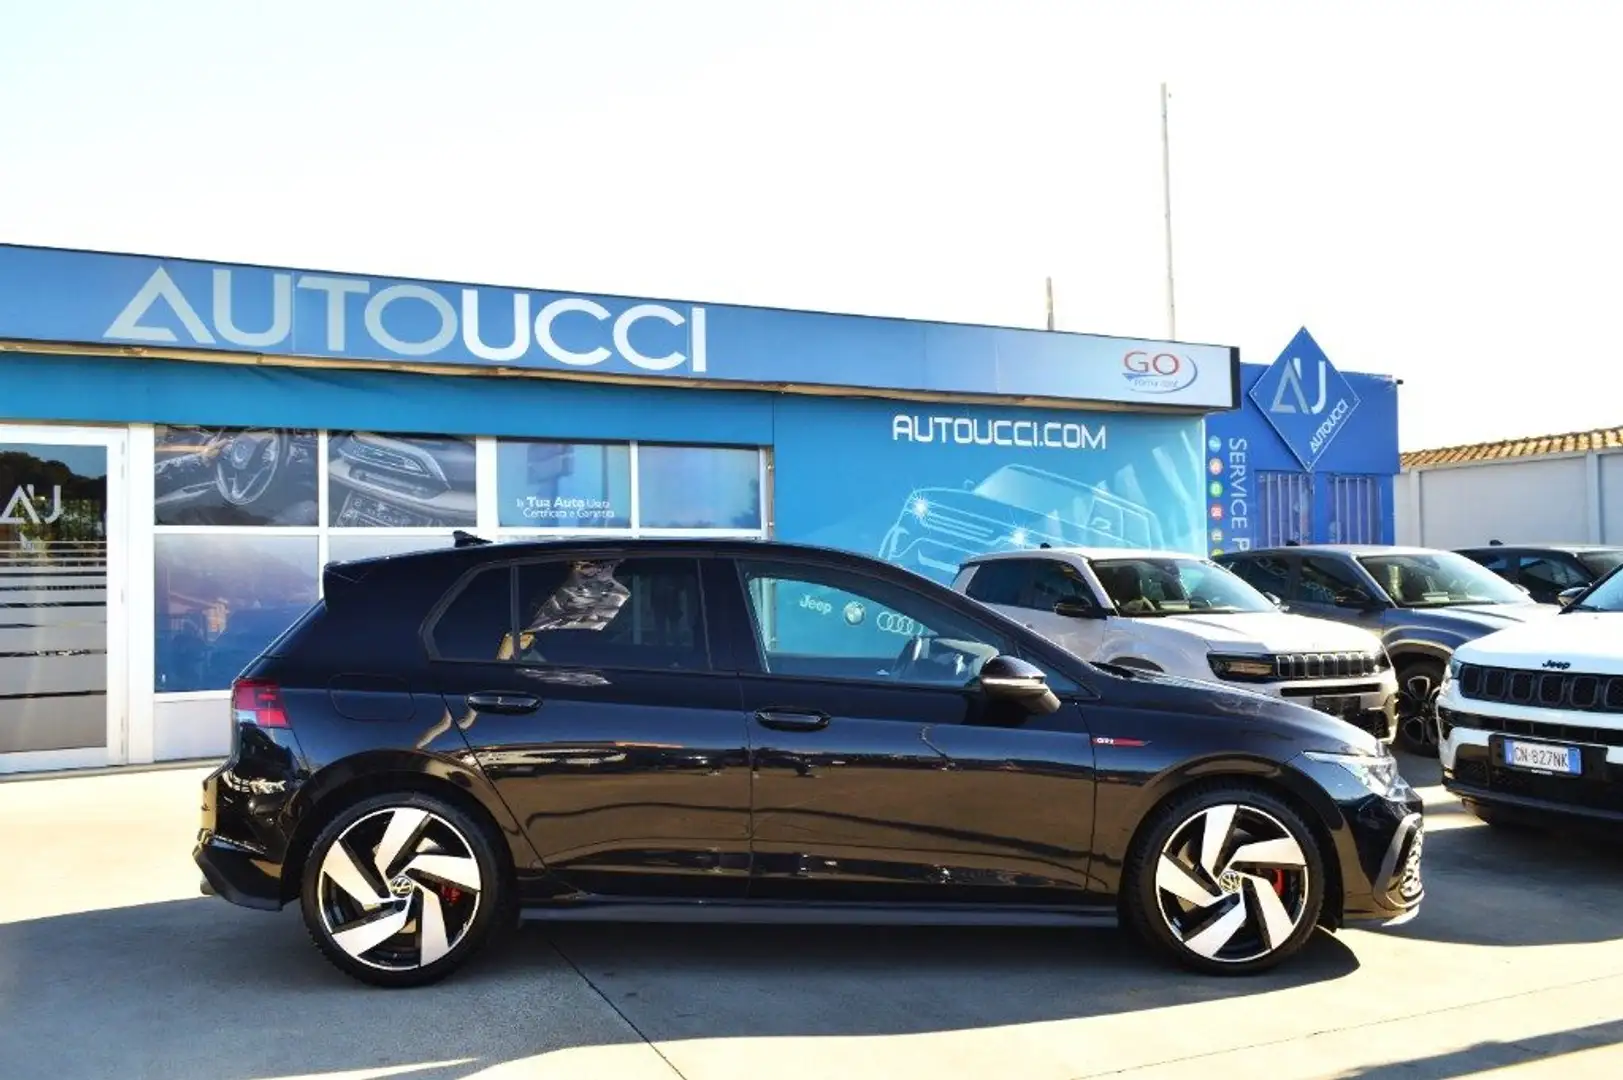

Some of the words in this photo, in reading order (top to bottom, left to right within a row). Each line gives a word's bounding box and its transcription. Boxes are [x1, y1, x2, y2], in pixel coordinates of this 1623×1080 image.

[103, 266, 706, 372] AUTOUCCI
[1124, 351, 1179, 375] GO
[892, 415, 1106, 449] AUTOUCCI.COM
[1309, 398, 1348, 454] AUTOUCCI
[1229, 438, 1247, 528] SERVICE
[527, 496, 550, 507] Tua
[554, 497, 584, 508] Auto
[800, 595, 832, 615] Jeep
[1542, 660, 1571, 670] Jeep
